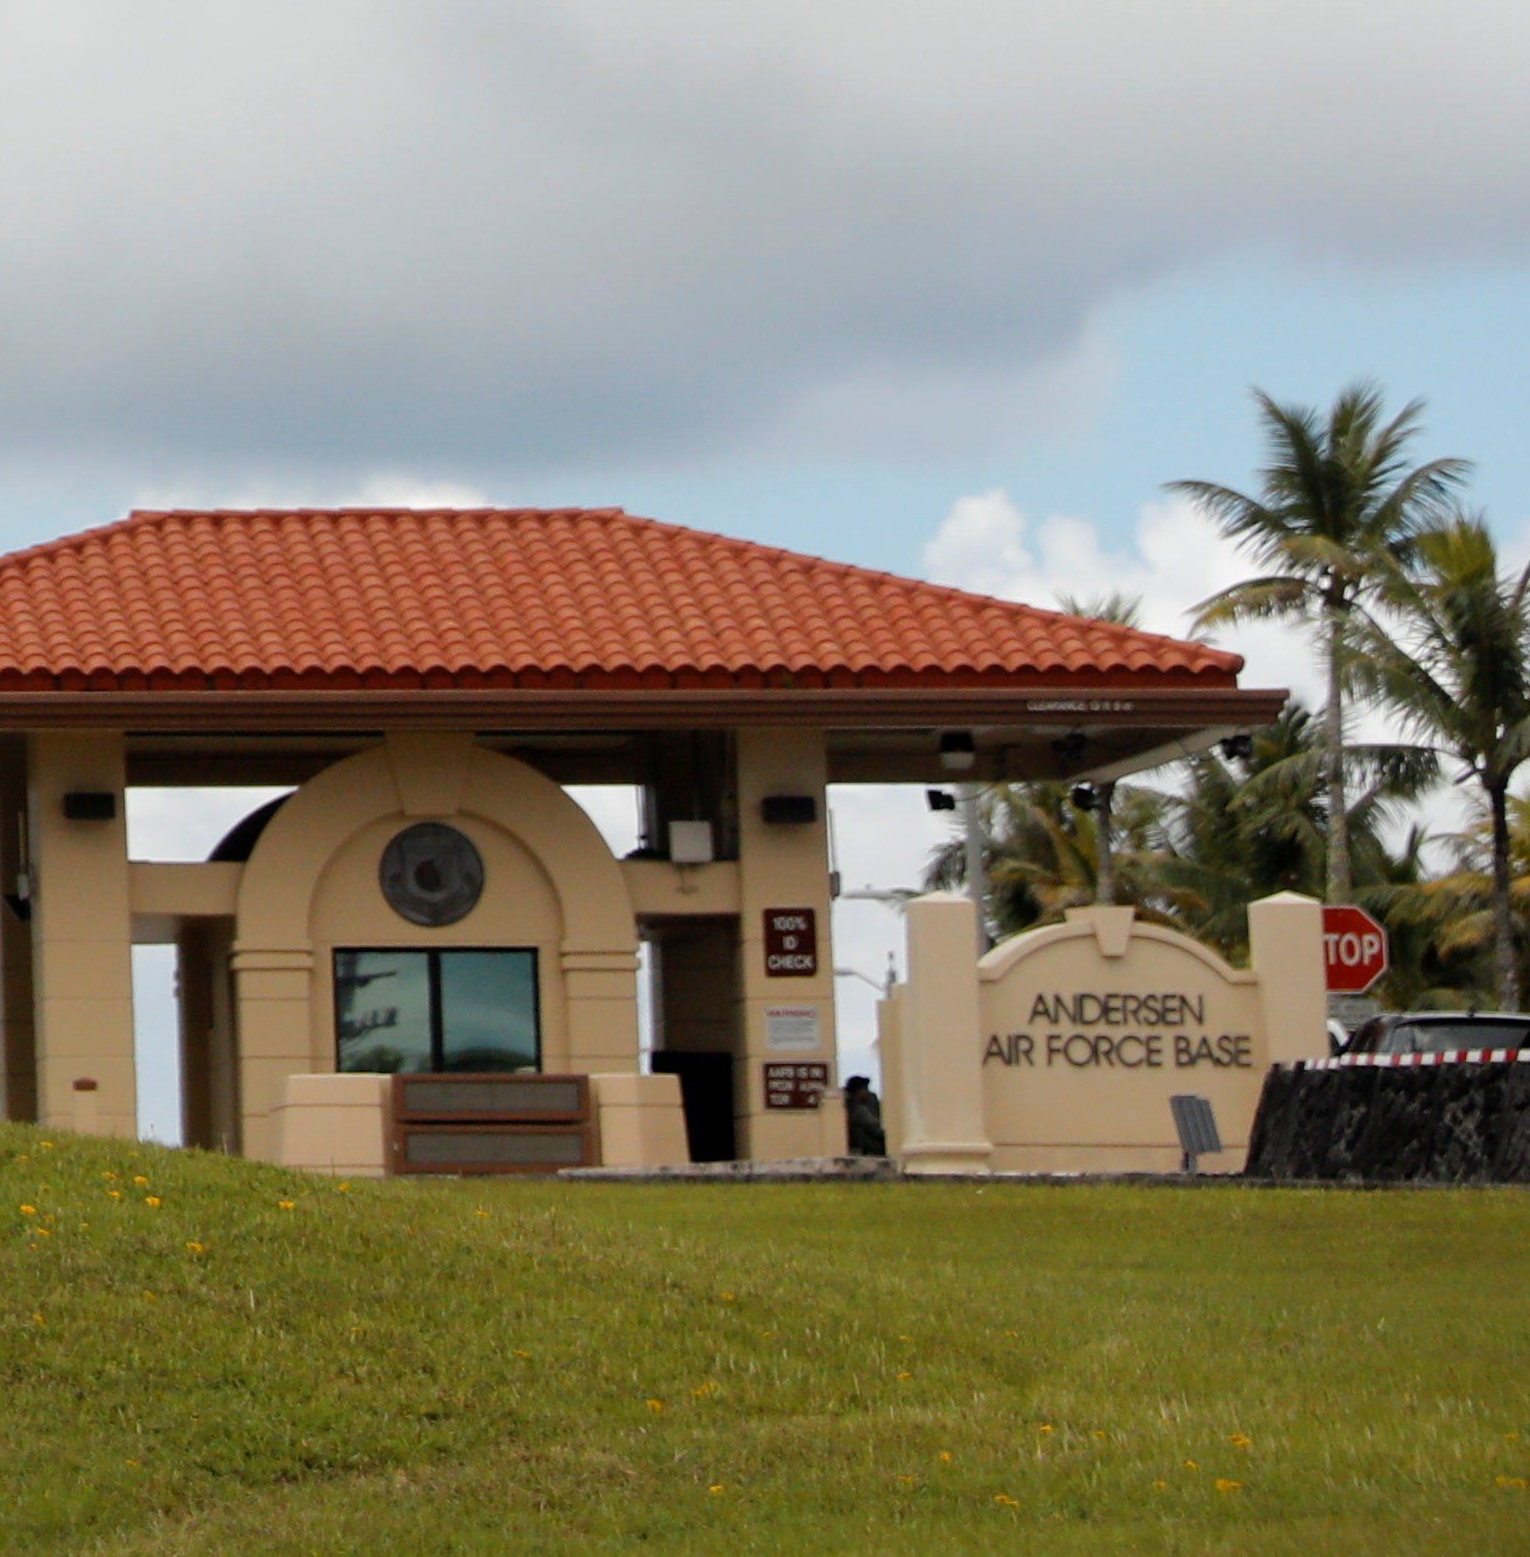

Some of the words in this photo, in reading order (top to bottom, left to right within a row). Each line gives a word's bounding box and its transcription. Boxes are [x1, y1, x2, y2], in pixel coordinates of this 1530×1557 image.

[772, 916, 807, 931] 100%
[782, 935, 799, 950] ID
[1323, 933, 1380, 967] TOP
[767, 954, 815, 970] CHECK
[1028, 994, 1204, 1025] ANDERSEN
[982, 1034, 1035, 1067] AIR
[1046, 1034, 1163, 1067] FORCE
[1175, 1034, 1252, 1068] BASE
